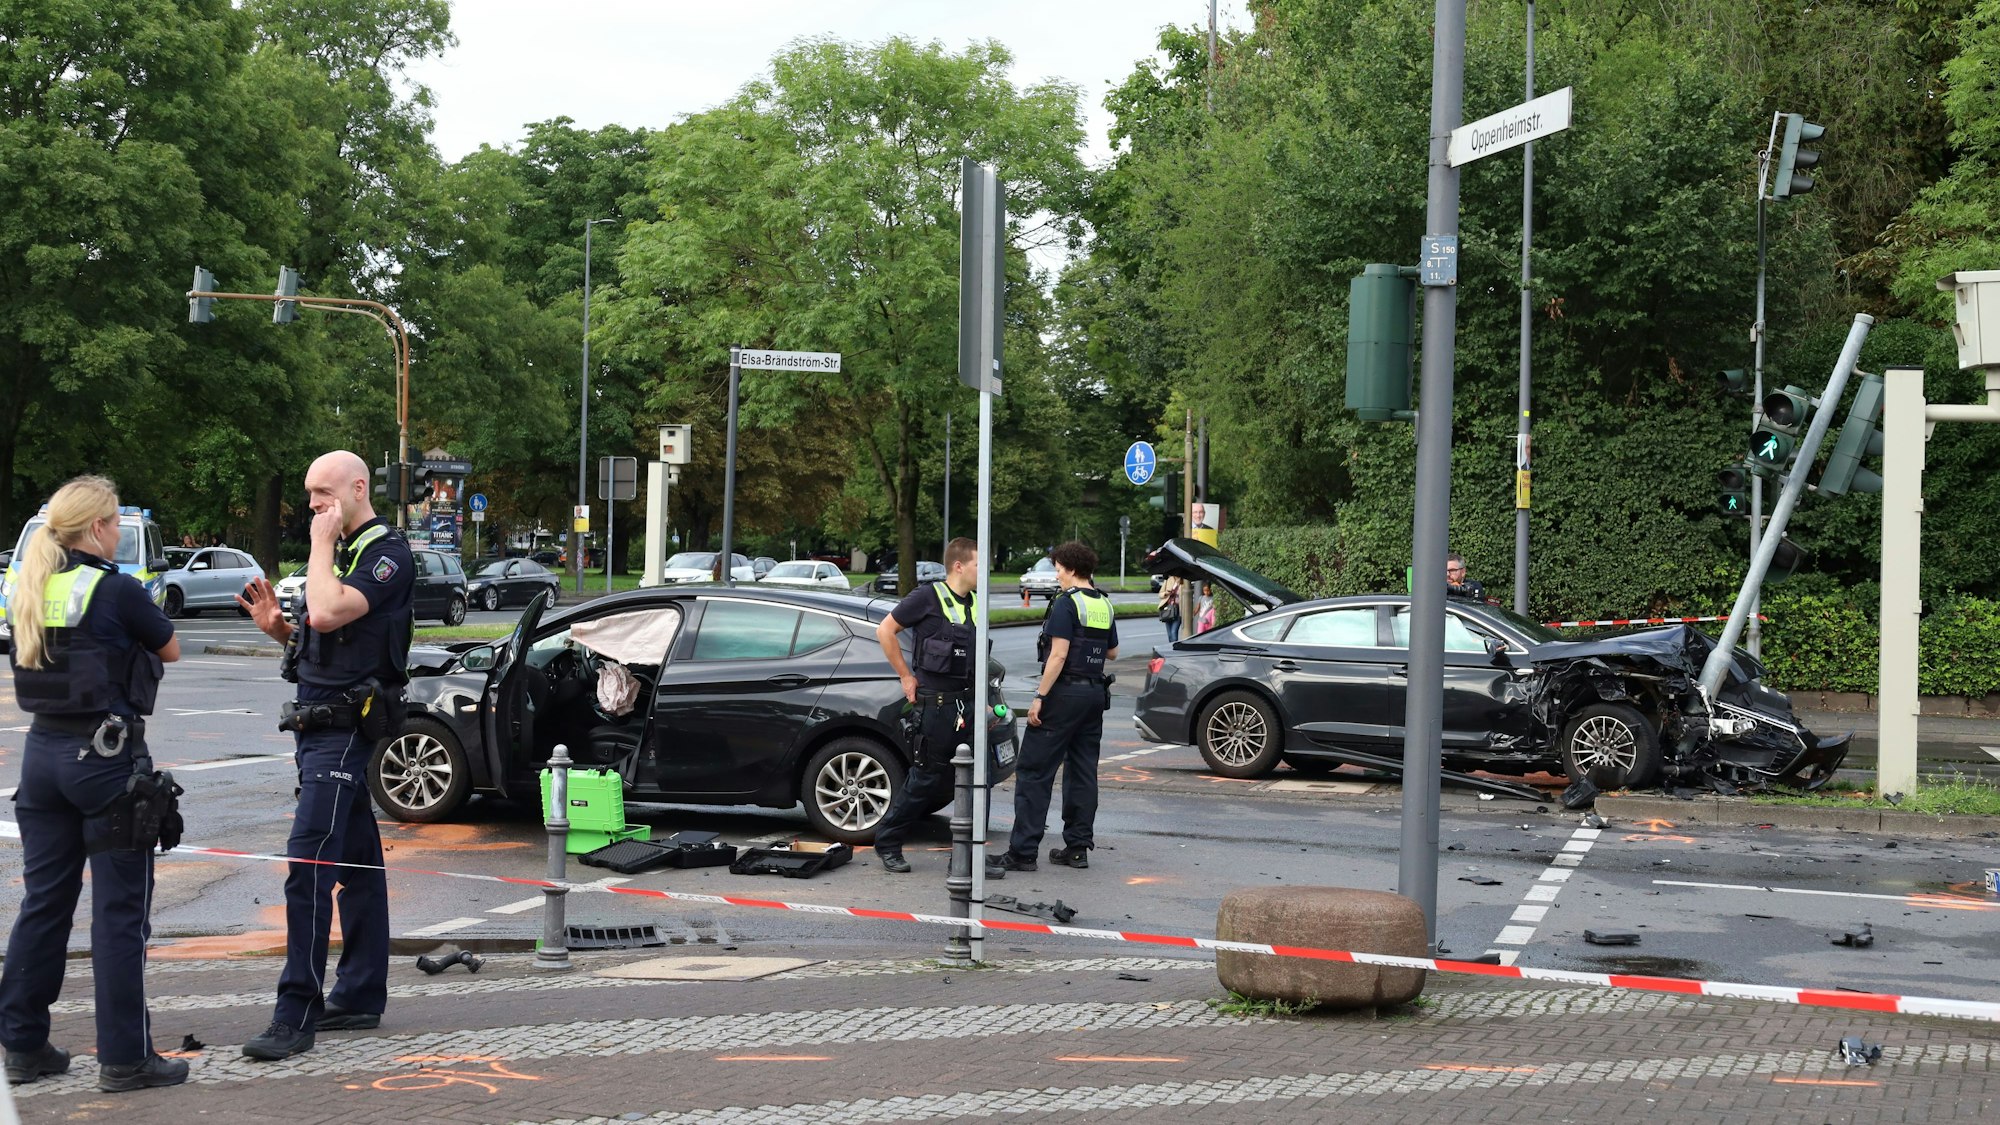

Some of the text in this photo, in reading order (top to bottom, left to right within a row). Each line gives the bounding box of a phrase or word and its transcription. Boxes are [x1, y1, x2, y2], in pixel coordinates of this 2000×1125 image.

[1471, 112, 1543, 154] Oppenheimstr.
[1431, 242, 1456, 254] S 150
[741, 353, 840, 369] Elsa-Brändström-Str.
[433, 531, 453, 539] TITANIC
[1088, 610, 1109, 623] POLIZEI
[1092, 647, 1102, 655] VU
[1086, 655, 1104, 664] Team
